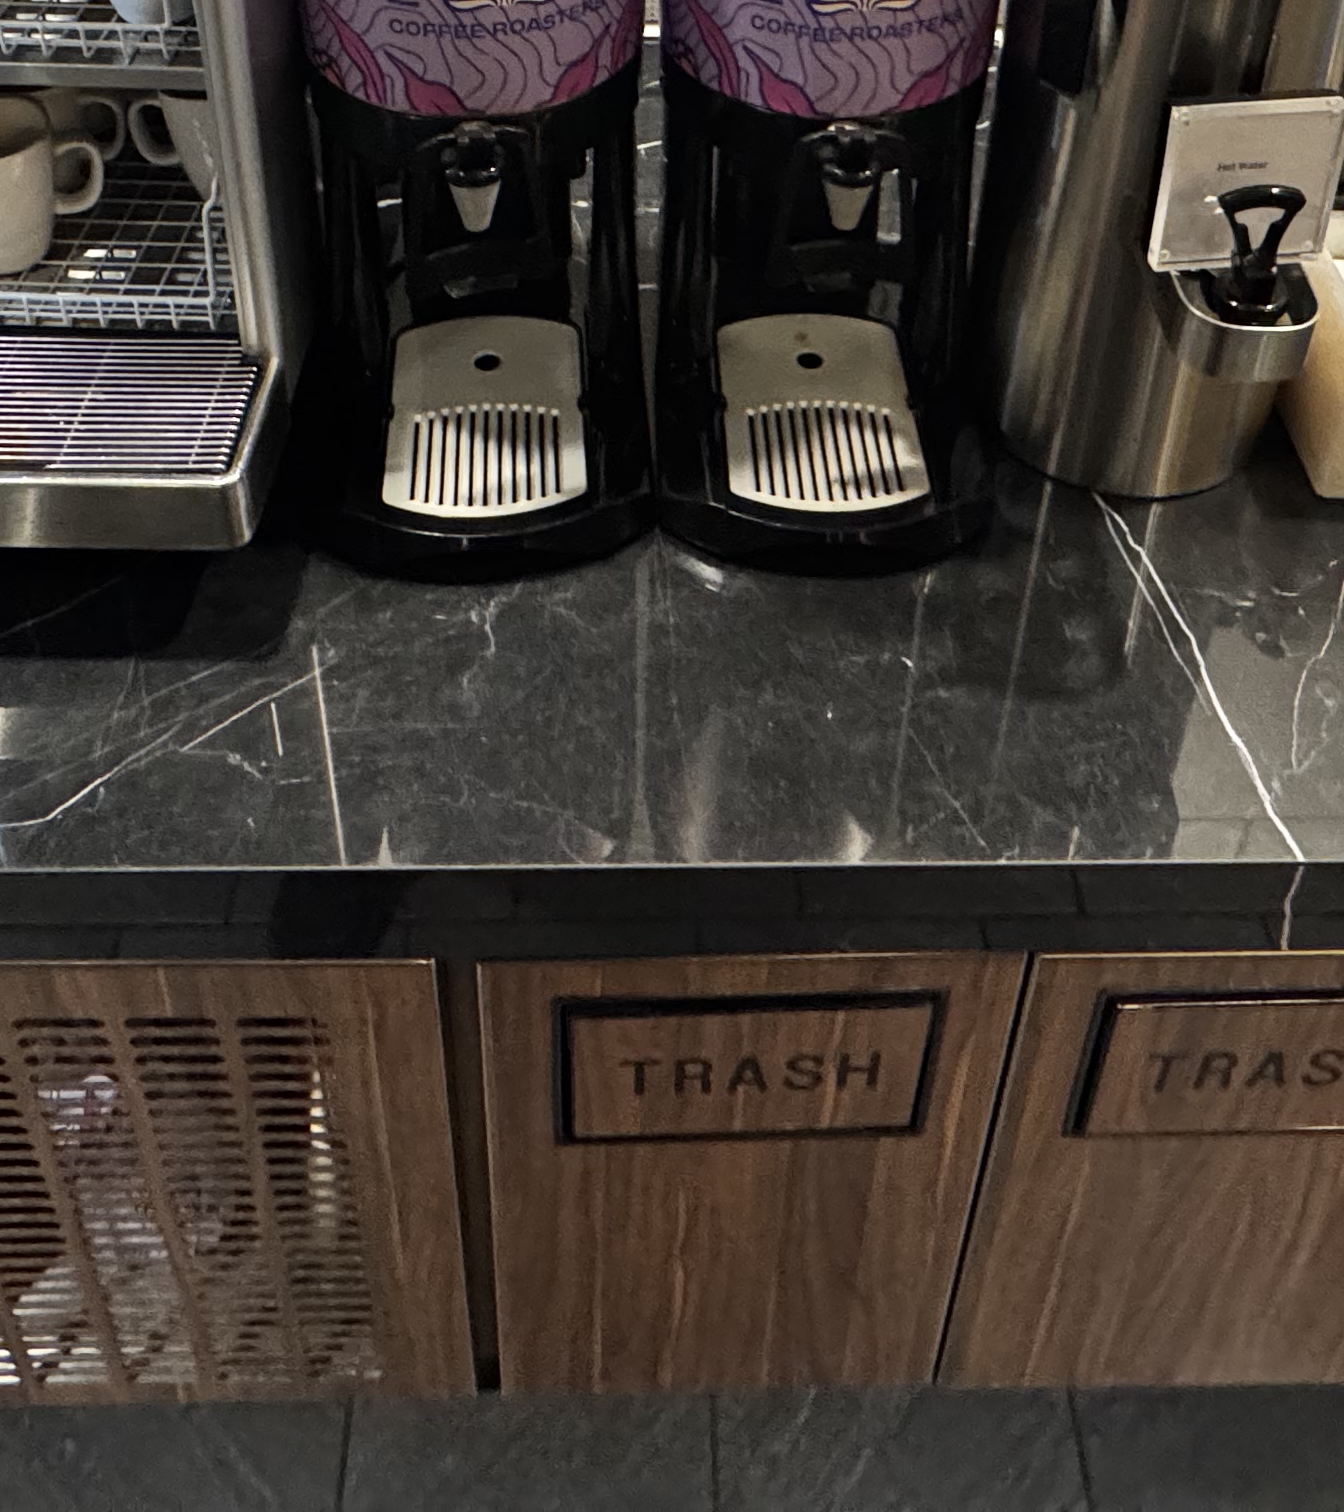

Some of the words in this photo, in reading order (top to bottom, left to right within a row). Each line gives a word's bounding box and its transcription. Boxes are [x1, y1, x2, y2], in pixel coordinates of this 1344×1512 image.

[389, 18, 486, 38] COFFEE
[751, 14, 844, 42] COFFEE
[848, 9, 964, 40] ROASTERS
[1216, 163, 1236, 172] Hot
[1238, 162, 1268, 171] Water
[618, 1050, 882, 1096] TRASH
